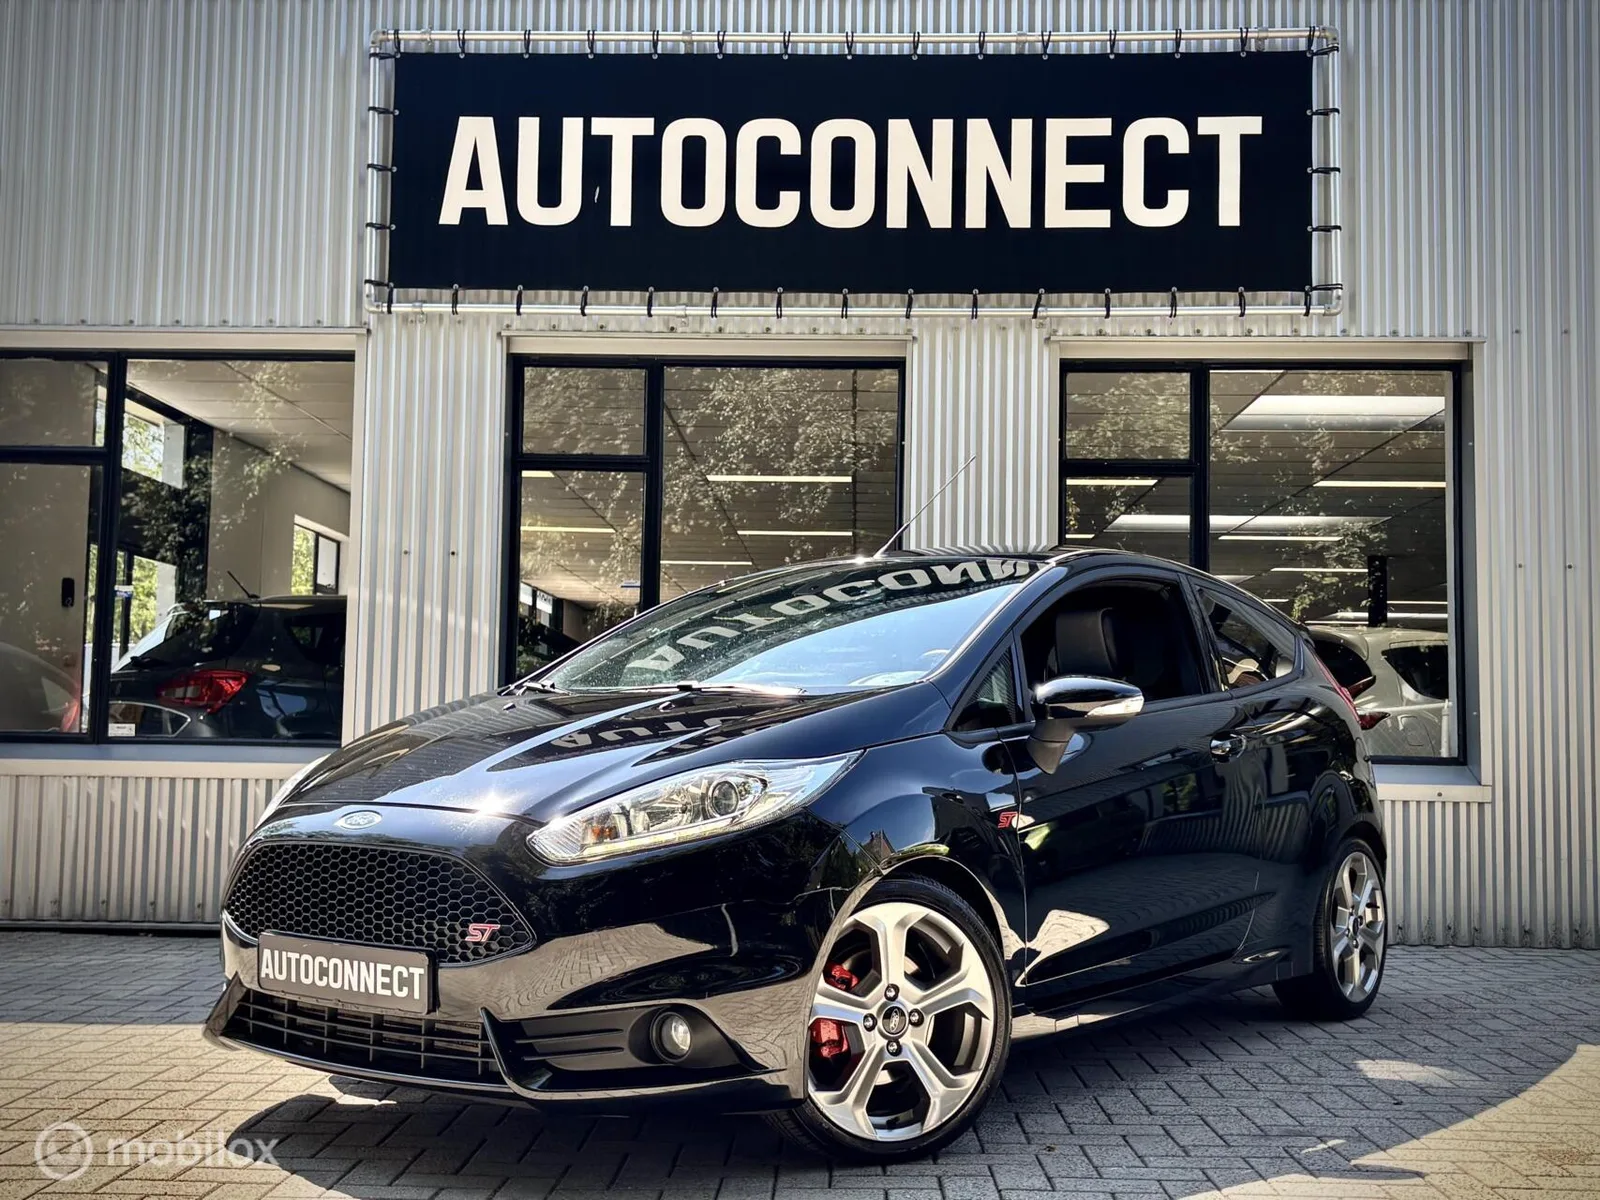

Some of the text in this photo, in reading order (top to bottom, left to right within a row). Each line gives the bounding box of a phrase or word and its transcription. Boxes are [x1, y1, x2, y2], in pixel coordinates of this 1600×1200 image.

[438, 115, 1263, 229] AUTOCONNECT
[998, 811, 1018, 828] ST
[464, 923, 501, 942] ST
[260, 948, 425, 1000] AUTOCONNECT
